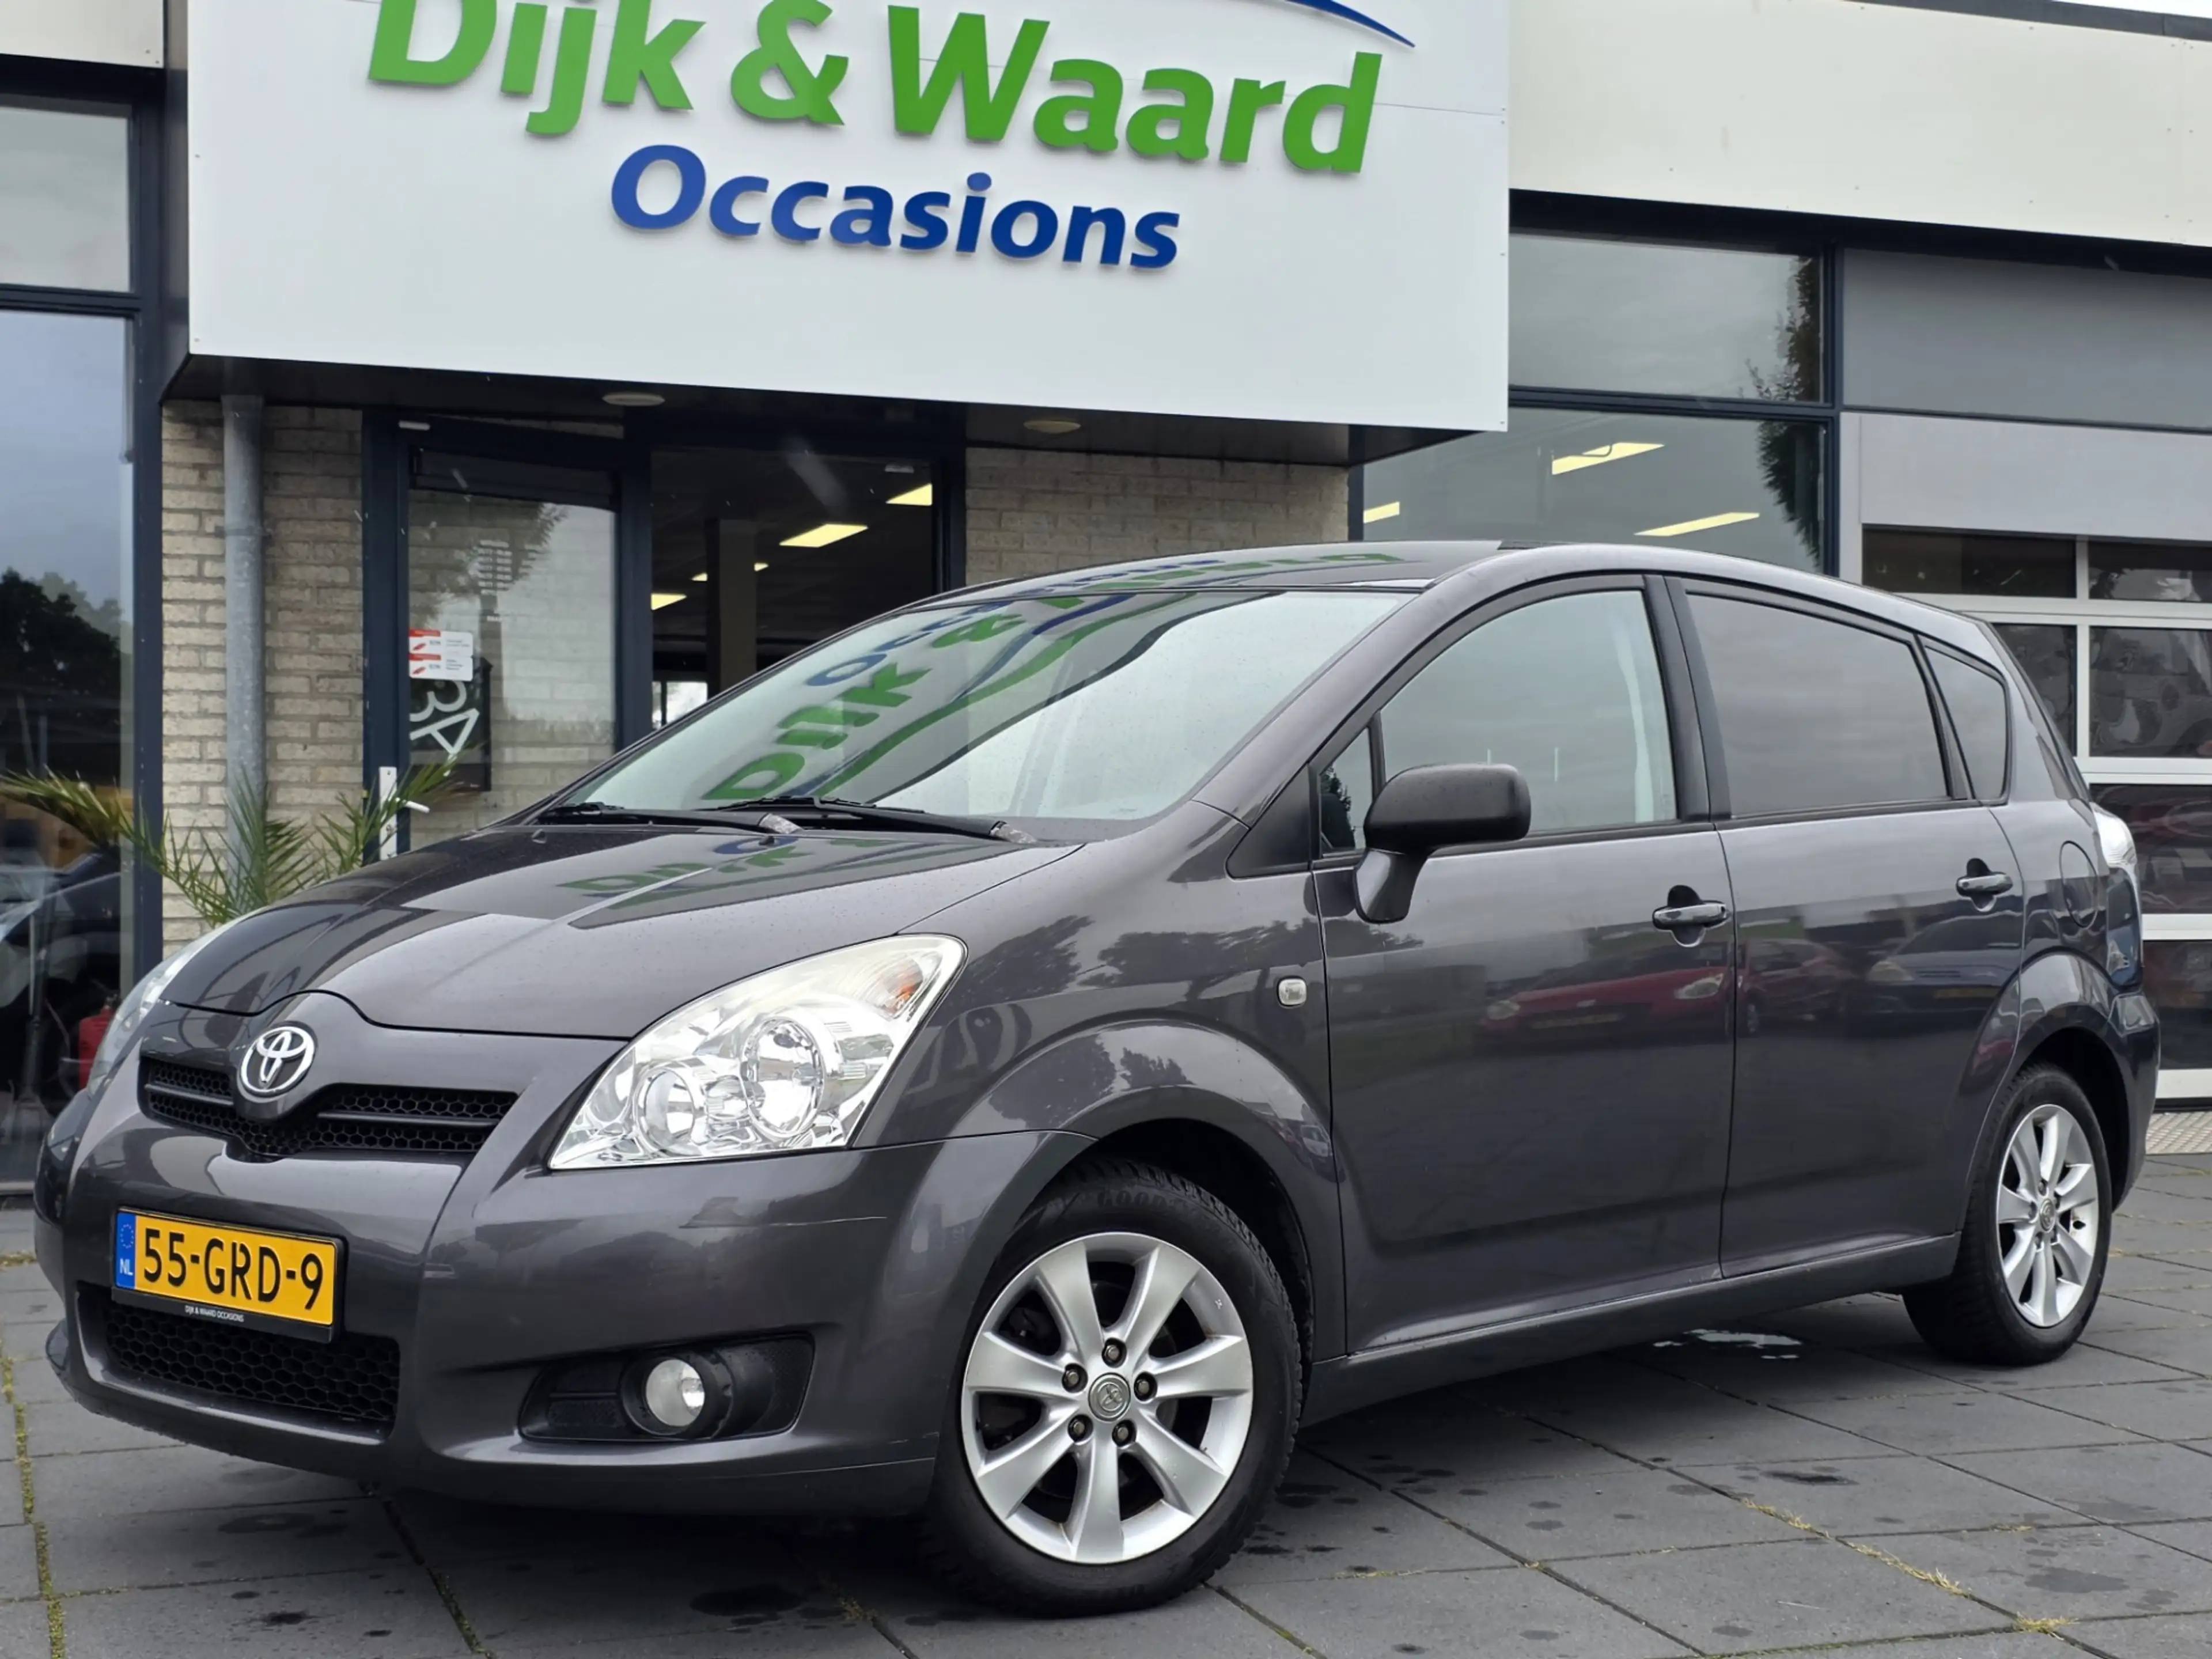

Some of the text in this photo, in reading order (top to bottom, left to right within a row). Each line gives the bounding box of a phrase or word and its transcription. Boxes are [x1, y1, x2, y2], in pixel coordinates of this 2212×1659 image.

[368, 0, 1383, 174] Dijk & Waard
[611, 144, 1180, 270] Occasions
[120, 1257, 134, 1276] NL
[143, 1227, 324, 1310] 55-GRD-9
